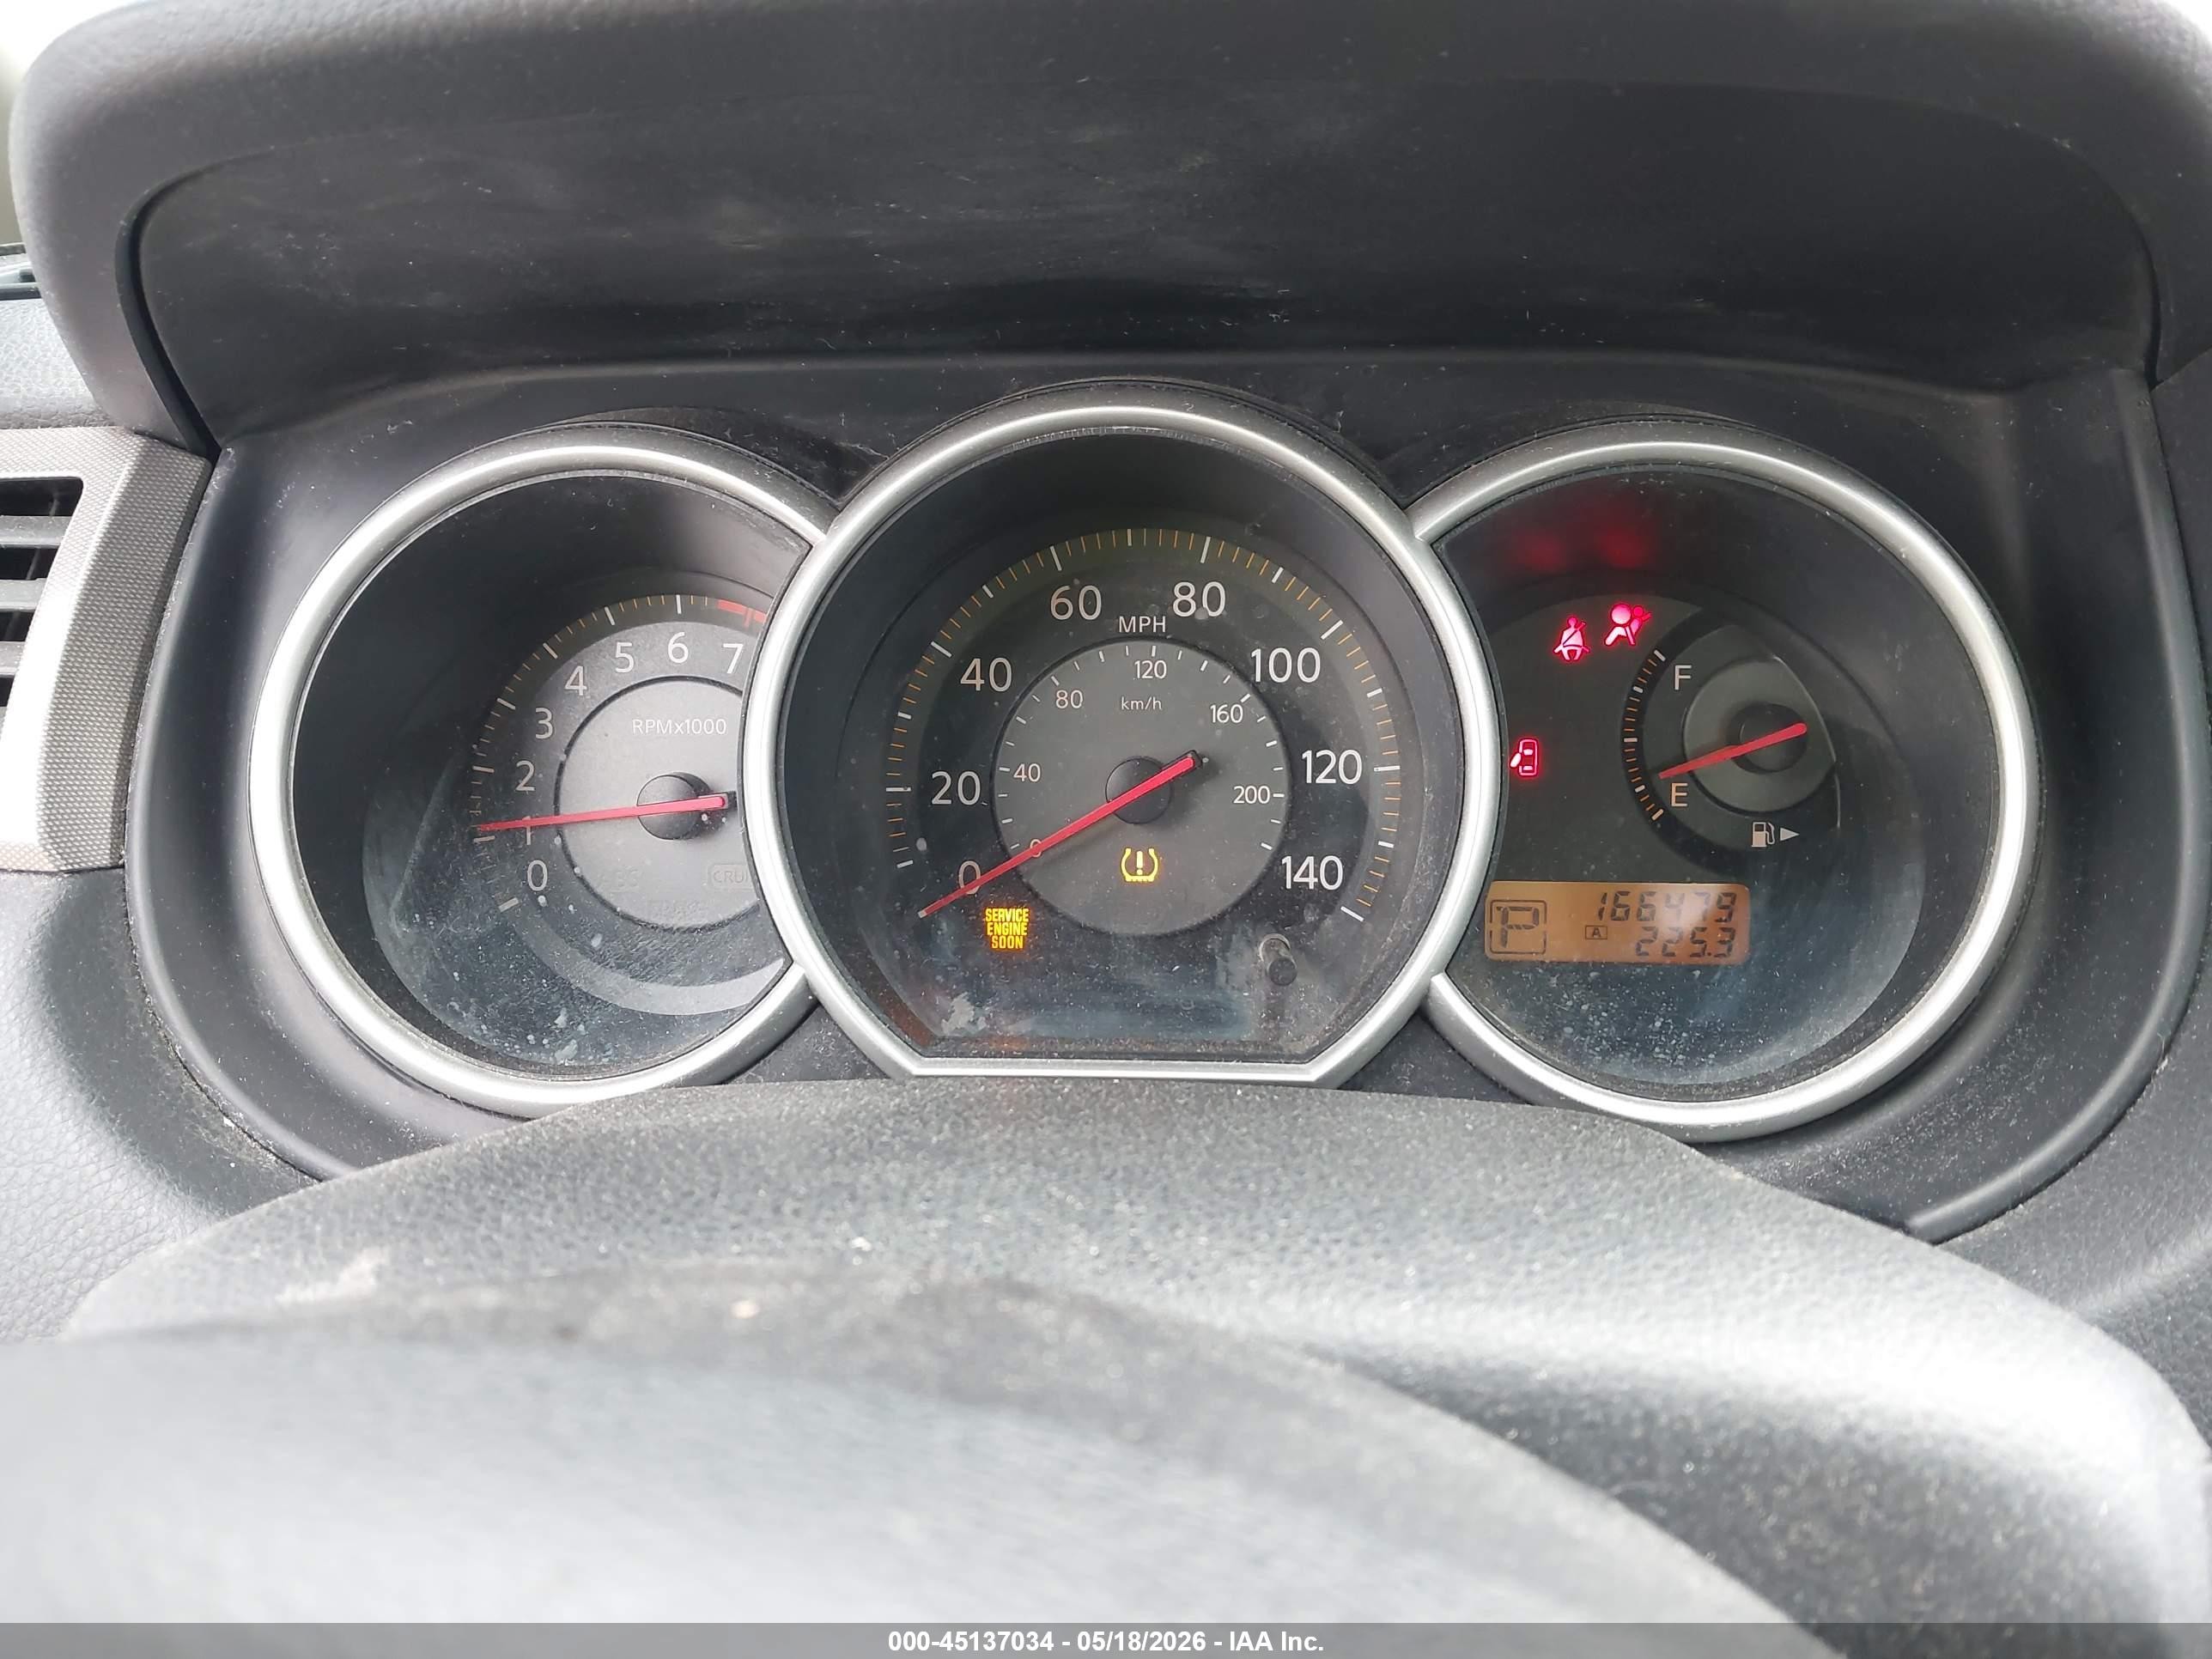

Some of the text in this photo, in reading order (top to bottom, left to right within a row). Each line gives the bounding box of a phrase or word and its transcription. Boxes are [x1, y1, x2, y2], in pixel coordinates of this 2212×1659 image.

[1050, 585, 1103, 620] 60
[1172, 581, 1226, 617] 80
[1118, 616, 1166, 633] MPH
[615, 641, 635, 672] 5
[667, 632, 688, 663] 6
[722, 643, 744, 673] 7
[564, 665, 587, 696] 4
[960, 658, 1012, 691] 40
[1134, 660, 1167, 678] 120
[1250, 647, 1321, 683] 100
[1674, 665, 1692, 690] F
[1055, 690, 1083, 708] 80
[1121, 696, 1163, 711] km/h
[1210, 704, 1243, 723] 160
[535, 707, 553, 738] 3
[632, 718, 726, 735] RPMx1000
[515, 760, 535, 791] 2
[1013, 763, 1042, 782] 40
[1302, 750, 1363, 784] 120
[931, 771, 981, 805] 20
[1233, 787, 1271, 805] 200
[1670, 782, 1688, 807] E
[521, 815, 532, 846] 1
[527, 860, 548, 891] 0
[958, 860, 981, 895] 0
[1281, 856, 1343, 890] 140
[985, 908, 1030, 922] SERVICE
[1597, 890, 1737, 922] 166479
[987, 921, 1028, 936] ENGINE
[991, 935, 1024, 949] SOON
[1497, 906, 1540, 948] P
